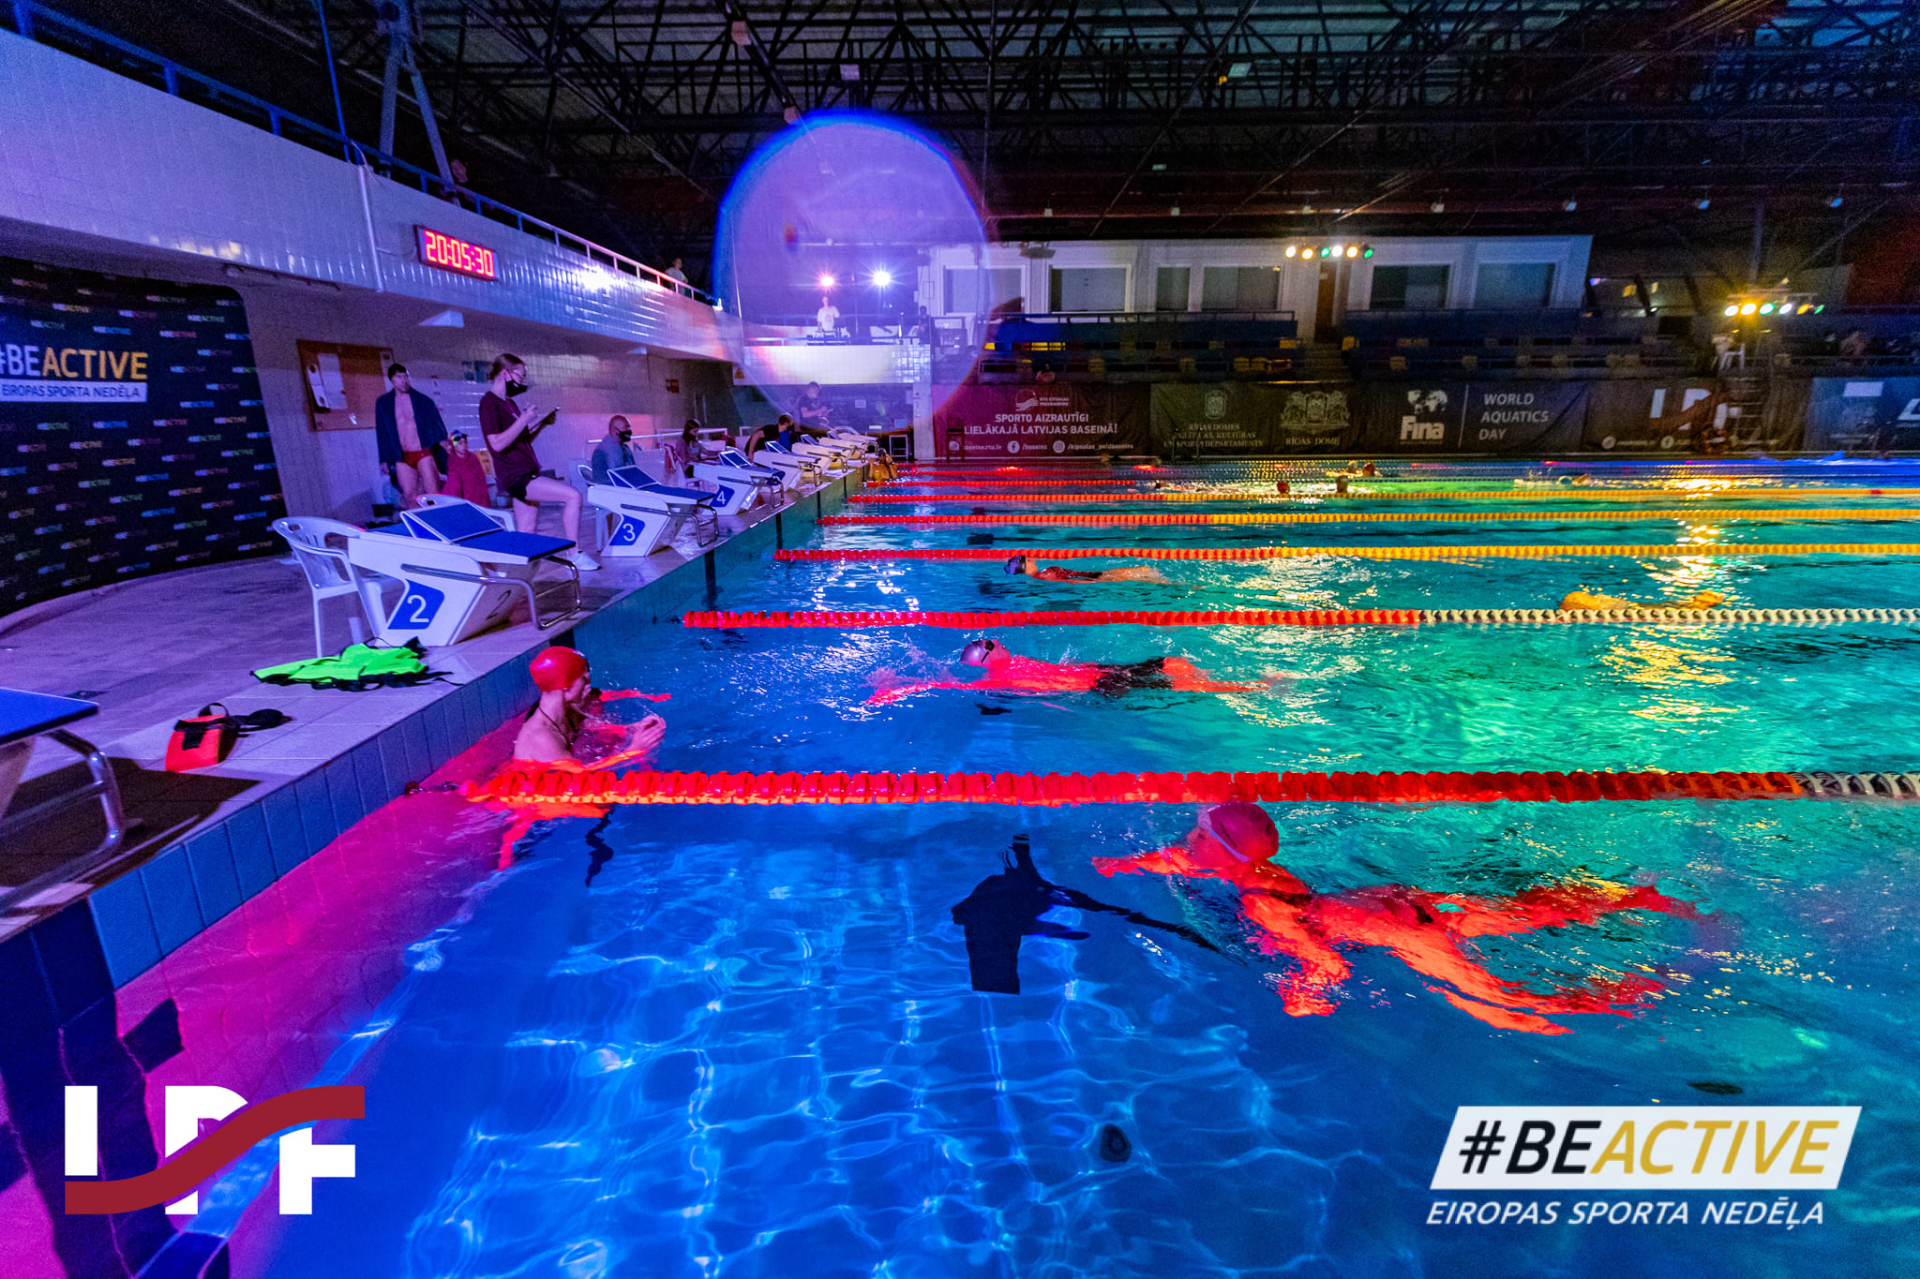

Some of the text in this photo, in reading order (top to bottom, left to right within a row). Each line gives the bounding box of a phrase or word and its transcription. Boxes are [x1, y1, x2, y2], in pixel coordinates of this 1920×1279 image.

[424, 230, 494, 277] 20:05:30
[2, 384, 45, 397] EIROPAS
[47, 385, 91, 397] SPORTA
[1484, 393, 1534, 405] WORLD
[995, 411, 1089, 423] SPORTO AIZRAUTĪGI
[1480, 410, 1549, 423] AQUATICS
[964, 423, 1118, 434] LIELĀKAJĀ LATVIJAS BASEINĀ!
[1478, 428, 1507, 440] DAY
[717, 491, 726, 505] 4
[622, 522, 637, 542] 3
[406, 594, 430, 623] 2
[486, 589, 511, 620] 2
